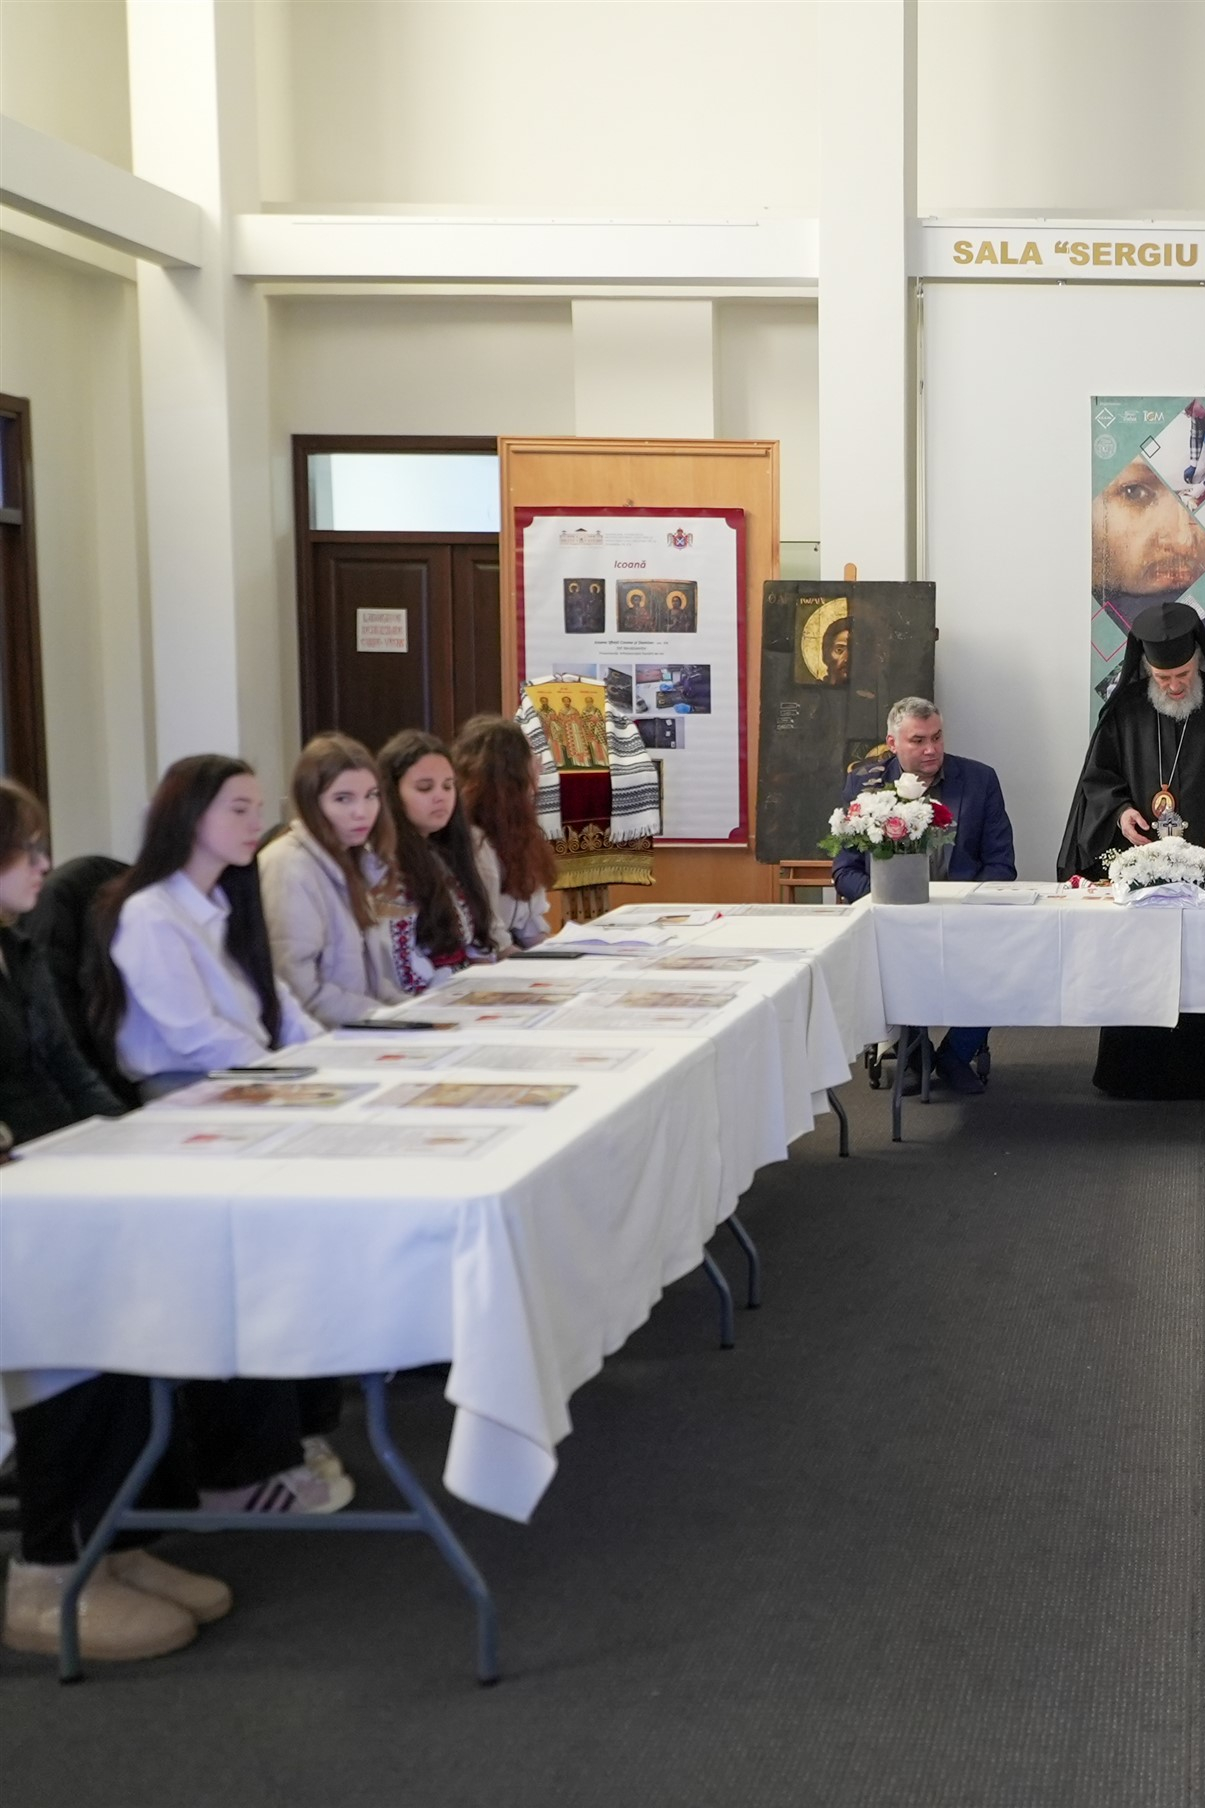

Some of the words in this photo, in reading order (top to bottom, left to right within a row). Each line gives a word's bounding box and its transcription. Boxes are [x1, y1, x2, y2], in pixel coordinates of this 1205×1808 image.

[952, 240, 1043, 265] SALA
[1054, 240, 1198, 267] “SERGIU
[613, 560, 647, 569] Icoană
